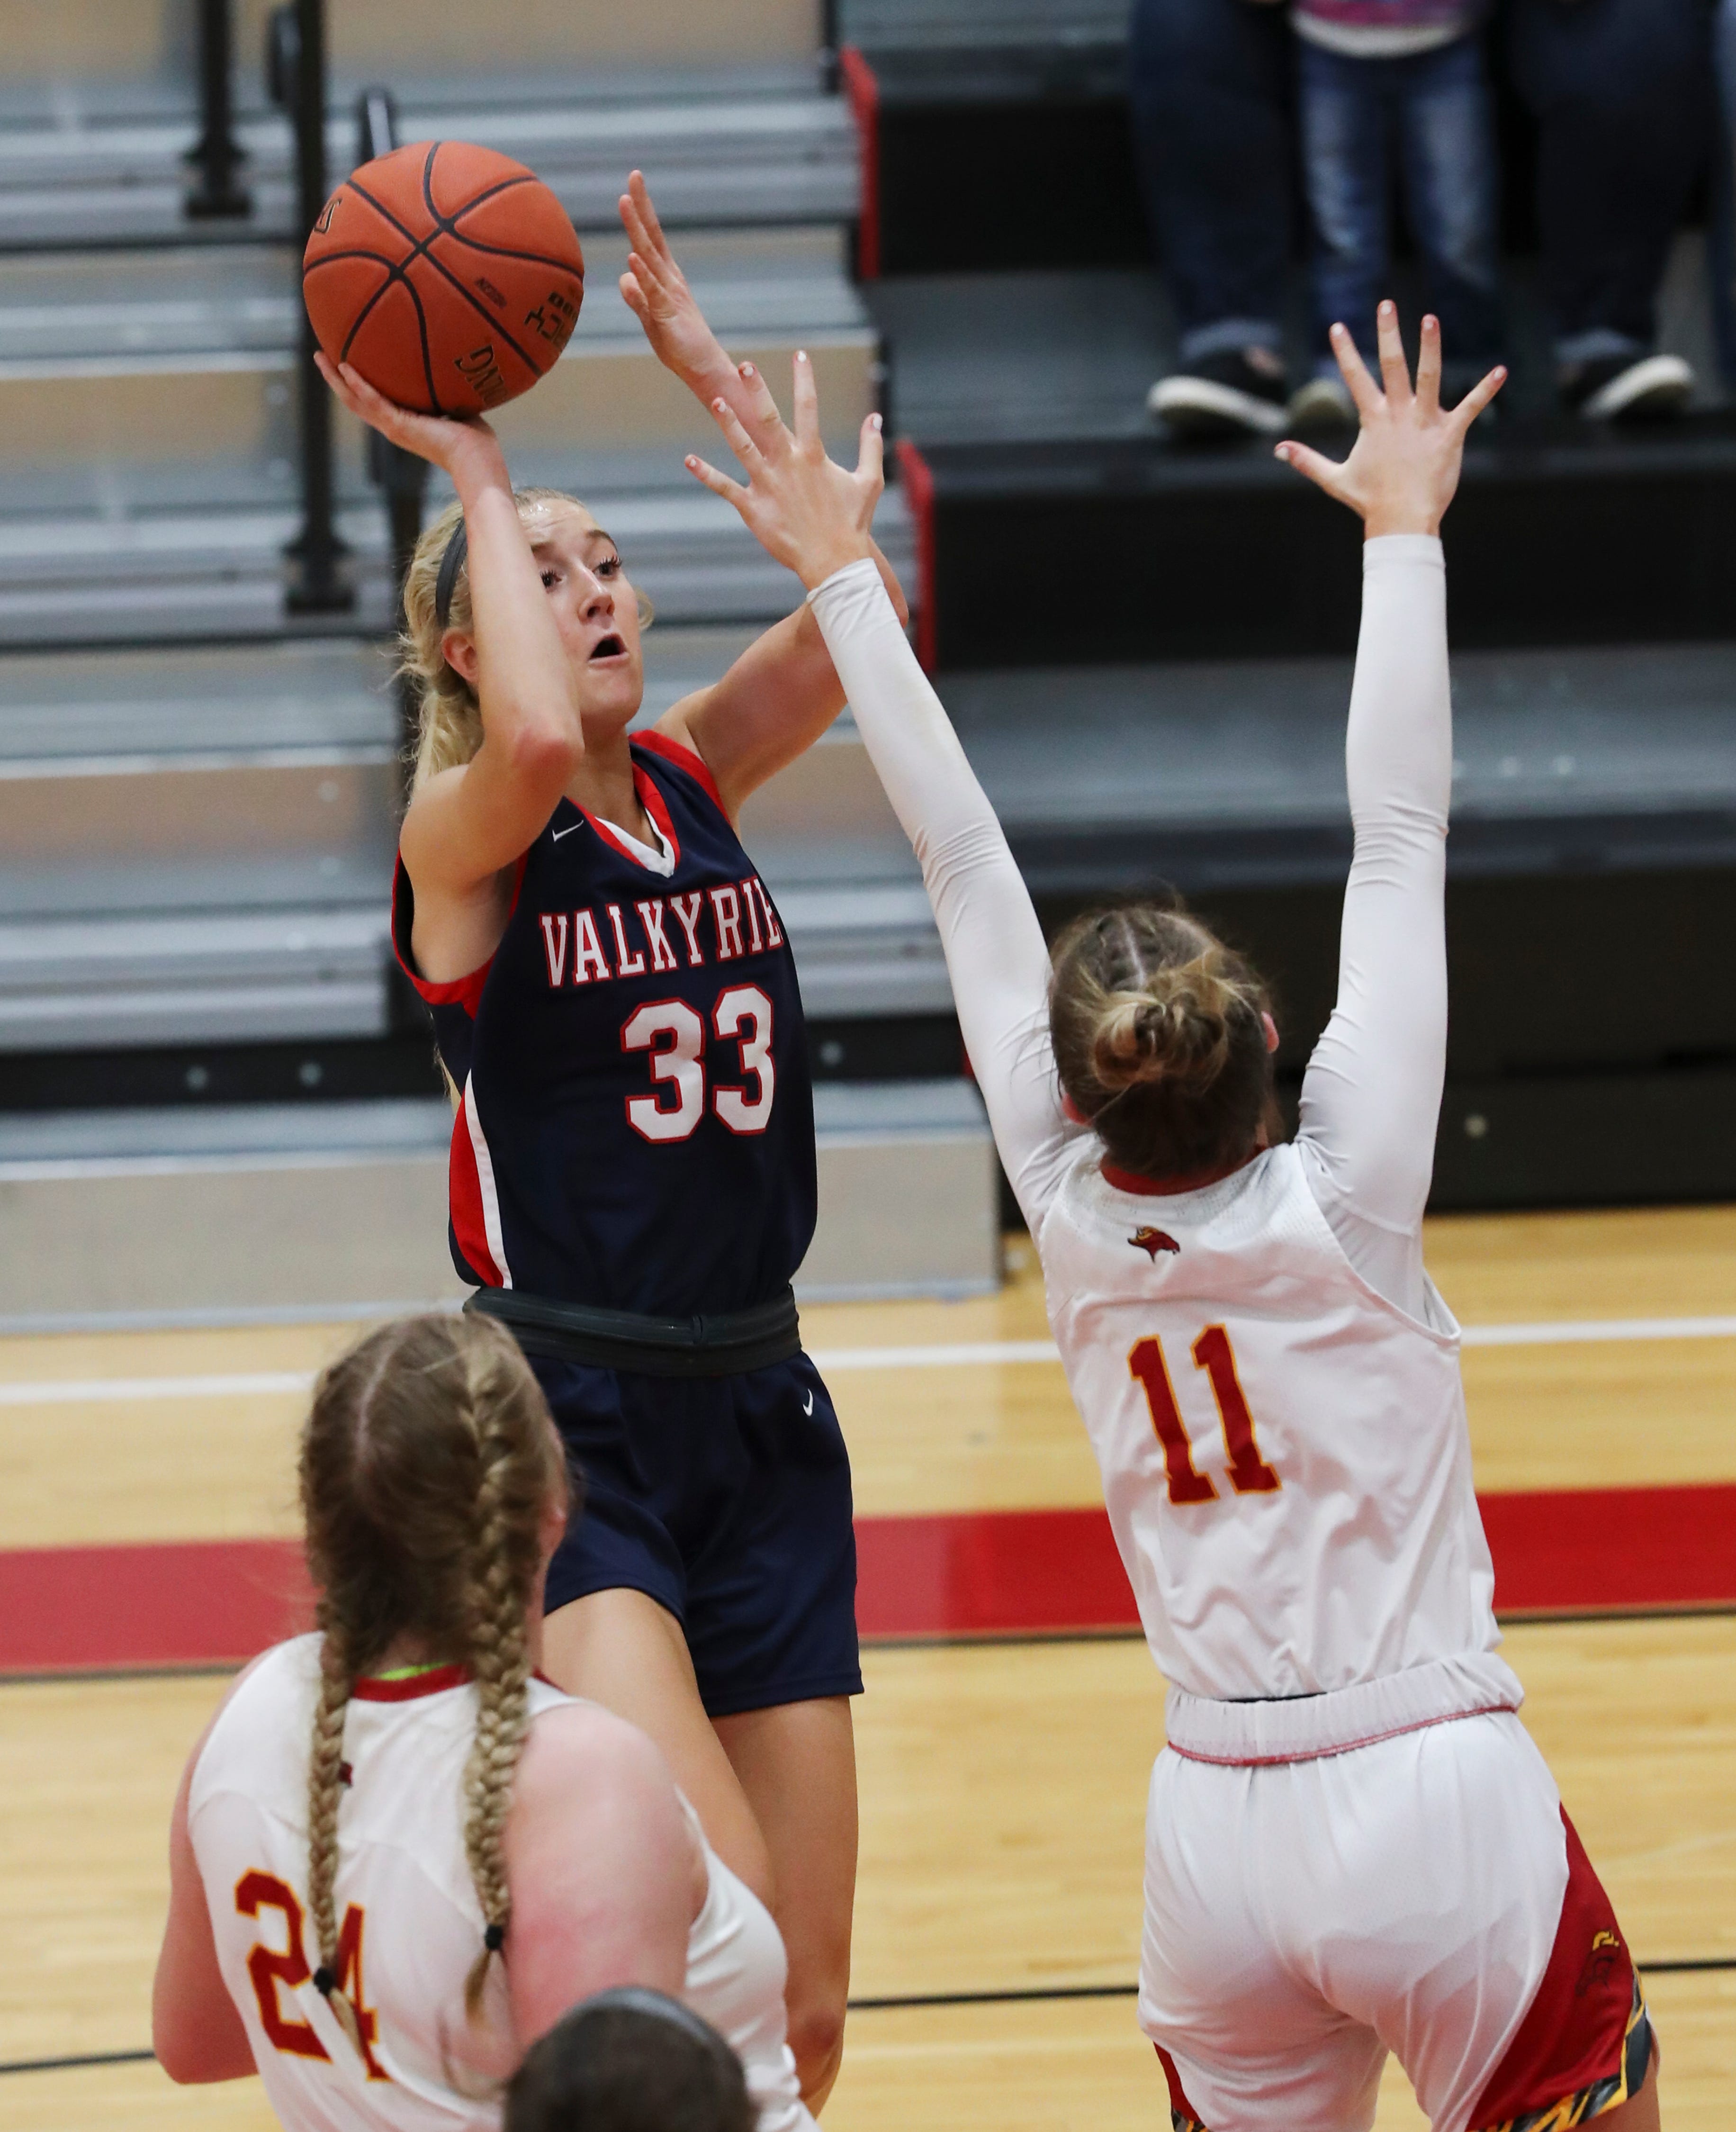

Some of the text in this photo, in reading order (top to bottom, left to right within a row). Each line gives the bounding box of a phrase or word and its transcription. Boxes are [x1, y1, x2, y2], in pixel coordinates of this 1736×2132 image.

[621, 982, 776, 1144] 33
[1127, 1323, 1282, 1505] 11
[234, 1867, 393, 2083] 24
